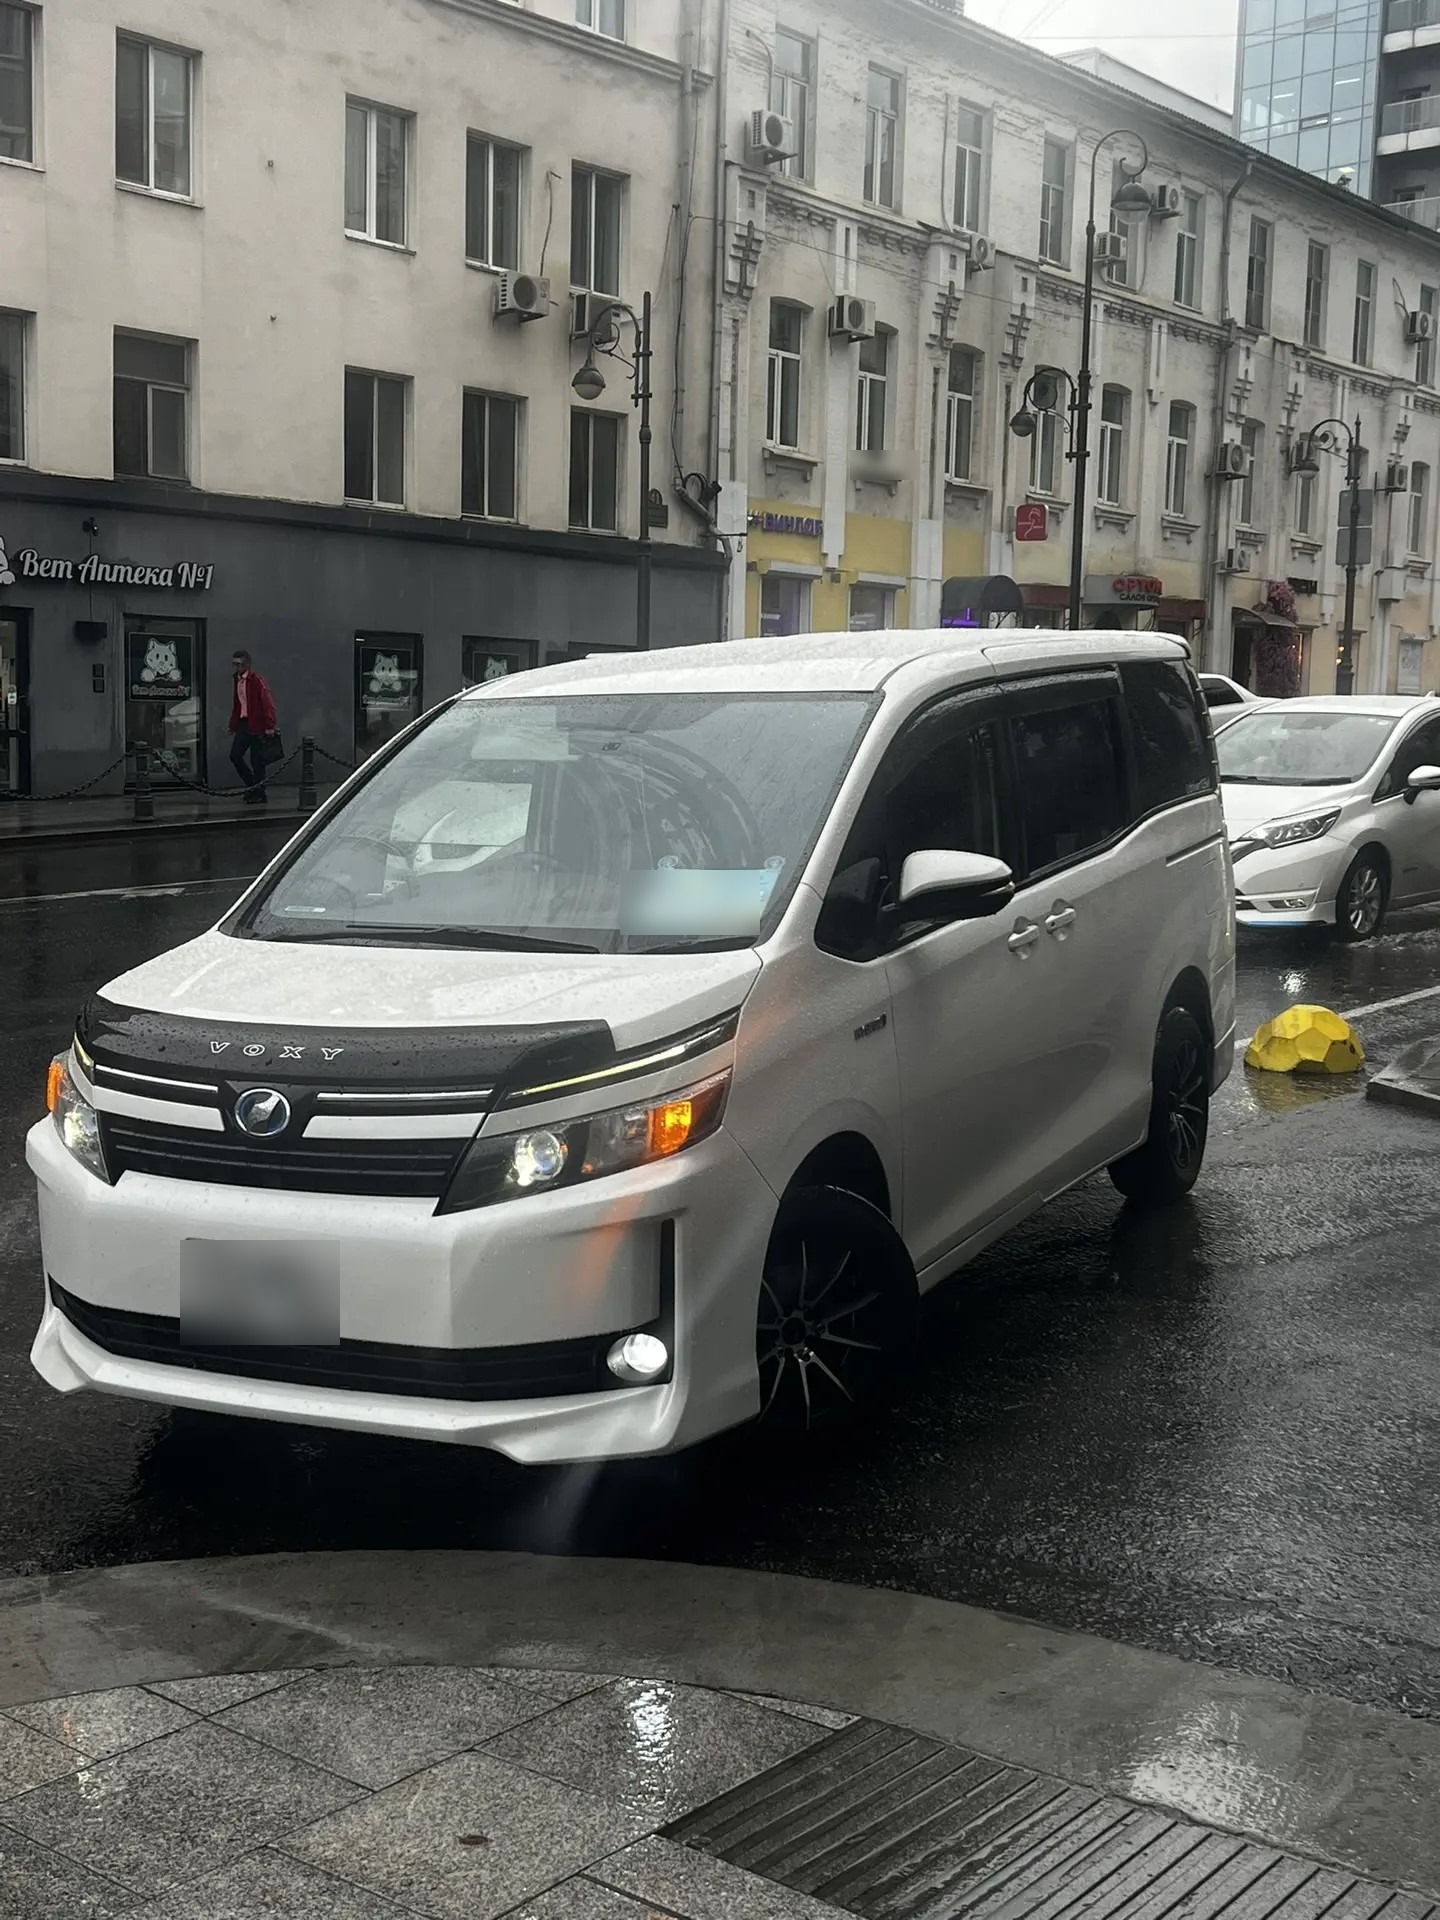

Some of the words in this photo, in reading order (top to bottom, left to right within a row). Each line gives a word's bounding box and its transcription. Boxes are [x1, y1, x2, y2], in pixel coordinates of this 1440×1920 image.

[19, 548, 73, 580] Вет
[78, 554, 173, 587] Аптека
[177, 562, 215, 590] №1
[209, 1040, 344, 1061] VOXY
